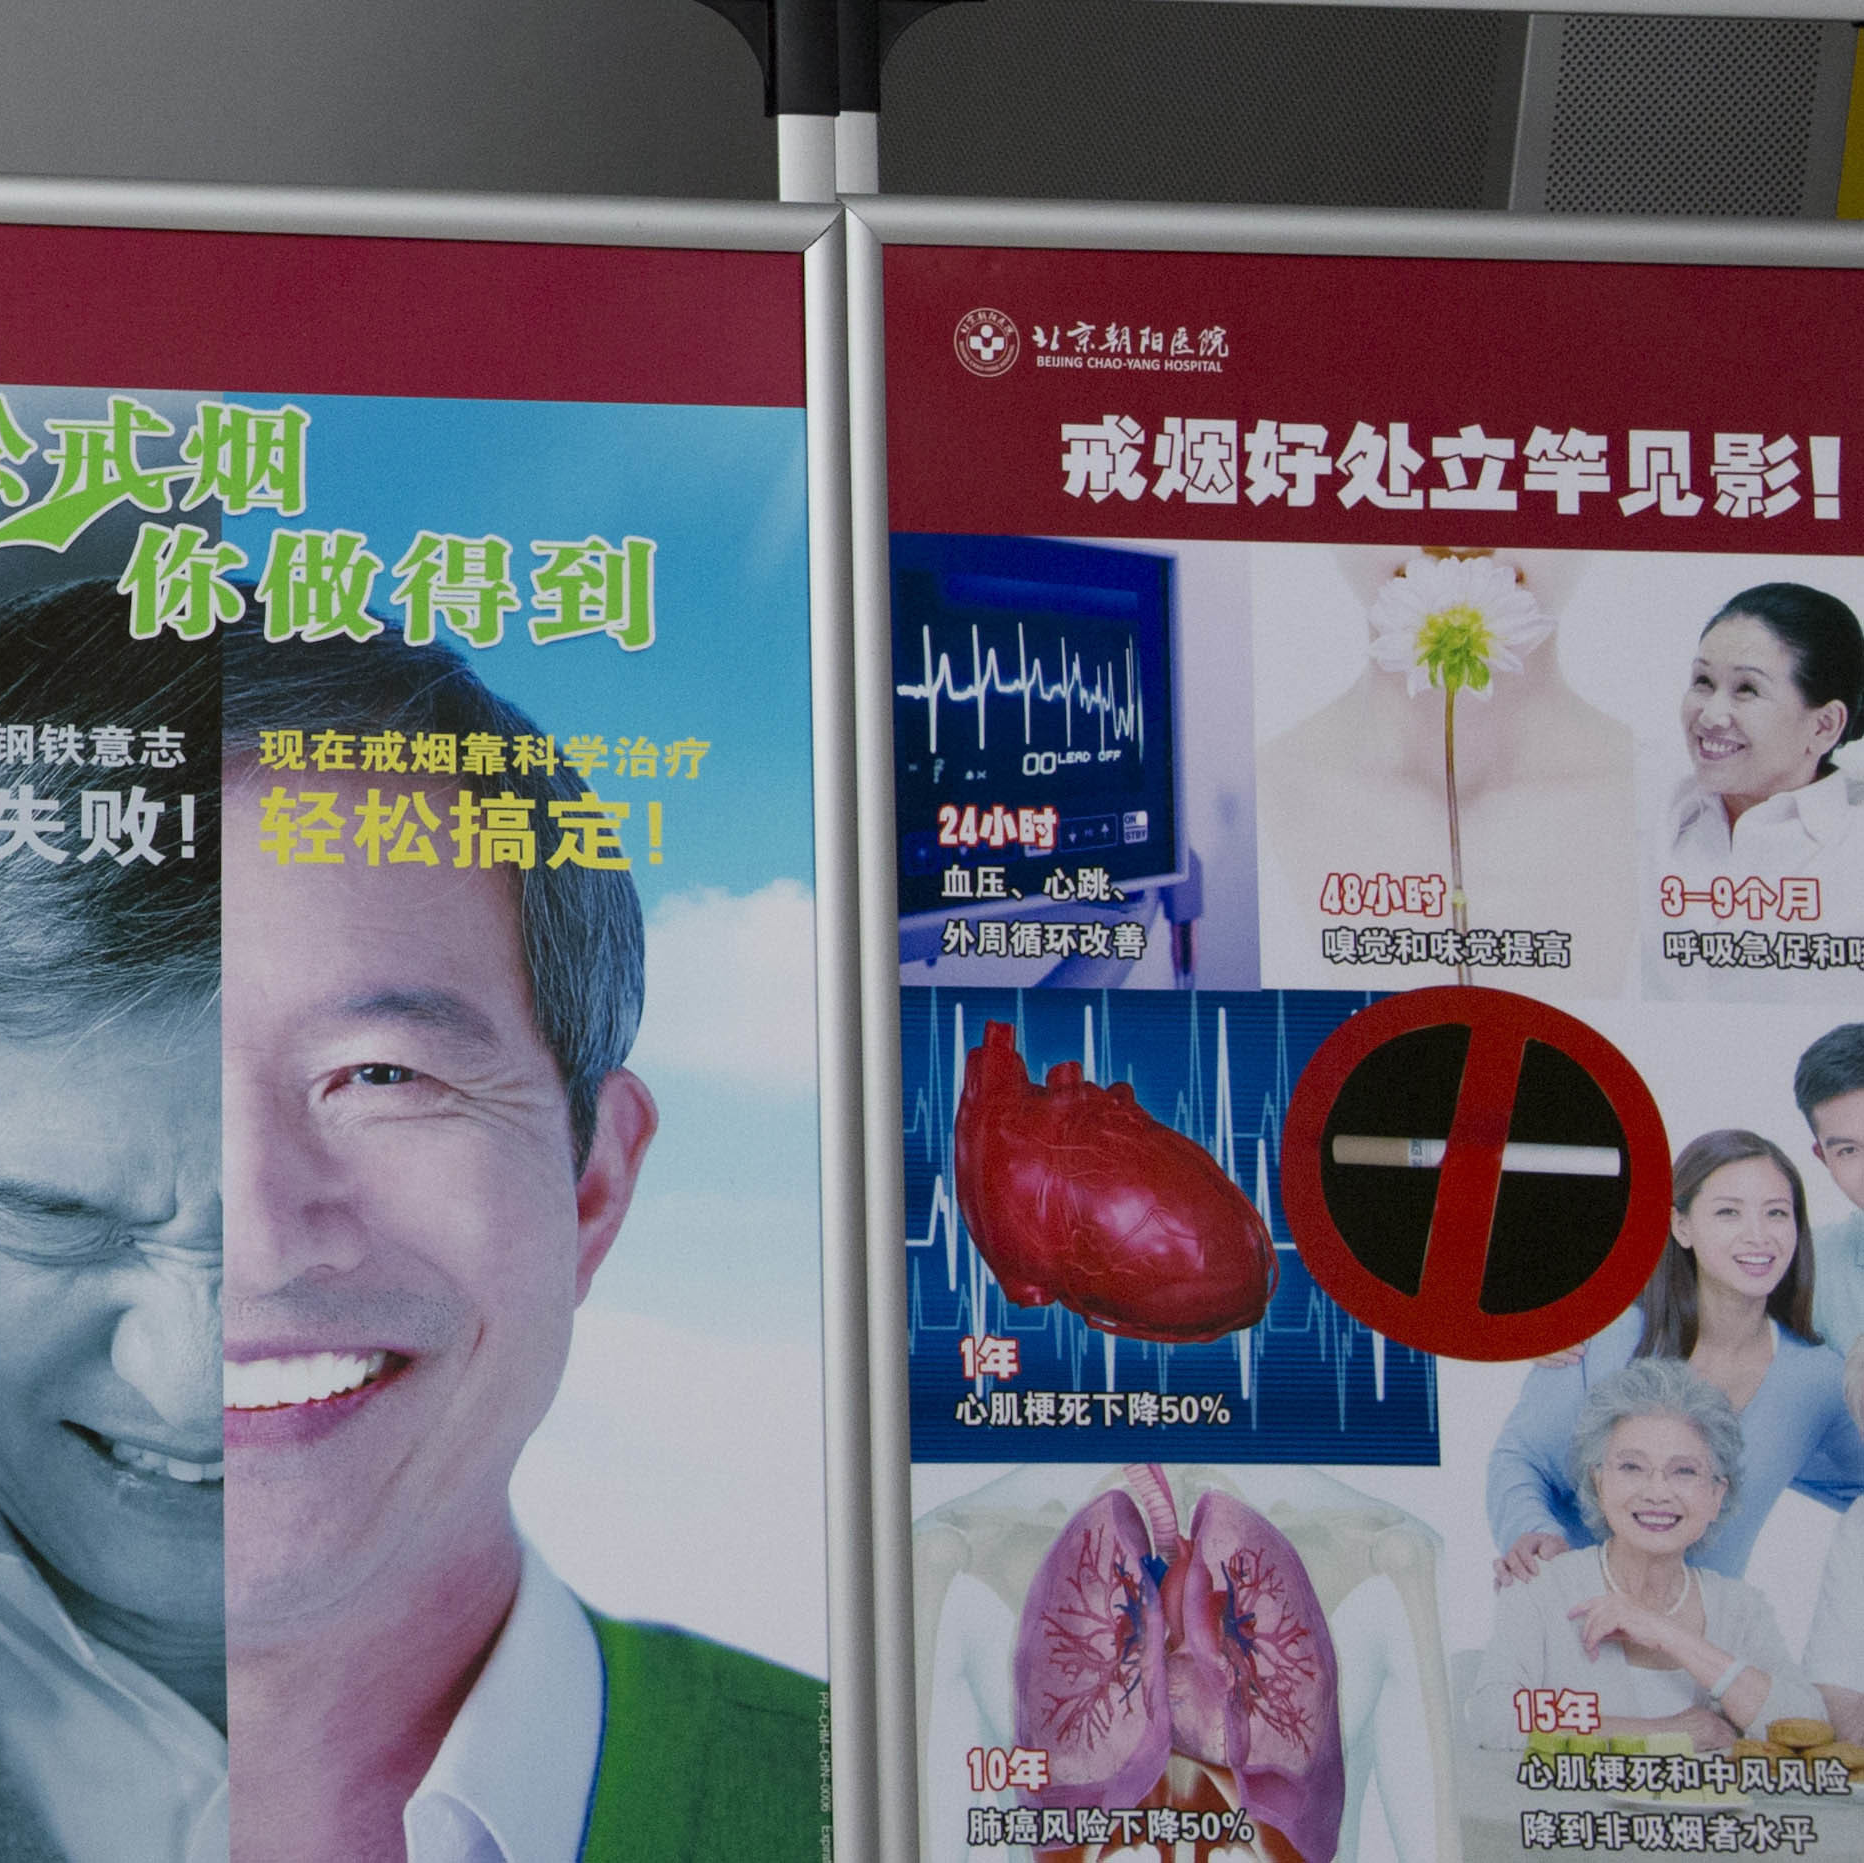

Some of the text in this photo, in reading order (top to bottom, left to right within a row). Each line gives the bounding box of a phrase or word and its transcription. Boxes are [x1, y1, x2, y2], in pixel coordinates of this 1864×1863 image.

[1031, 321, 1230, 358] 北京朝阳医院
[1036, 355, 1223, 373] BEIJING CHAO-YANG HOSPITAL
[1059, 413, 1843, 521] 戒烟好处立竿见影！
[117, 521, 658, 652] 你做得到
[258, 727, 712, 780] 现在戒烟靠科学治疗
[1058, 750, 1092, 765] LEAD
[1098, 749, 1123, 763] OFF
[258, 787, 666, 871] 轻松搞定！
[937, 804, 1060, 850] 24小时
[940, 864, 1128, 903] 血压、心跳、
[1320, 873, 1447, 918] 48小时
[941, 919, 1147, 960] 外周循环改善
[1322, 926, 1571, 969] 嗅觉和味觉提高
[959, 1335, 1021, 1382] 1年
[953, 1390, 1233, 1428] 心肌梗死下降50%
[1513, 1688, 1601, 1735] 15年
[967, 1746, 1051, 1793] 10年
[1517, 1753, 1853, 1796] 心肌梗死和中风风险
[967, 1805, 1257, 1847] 肺癌风险下降50%
[1521, 1809, 1818, 1855] 降到非吸烟者水平
